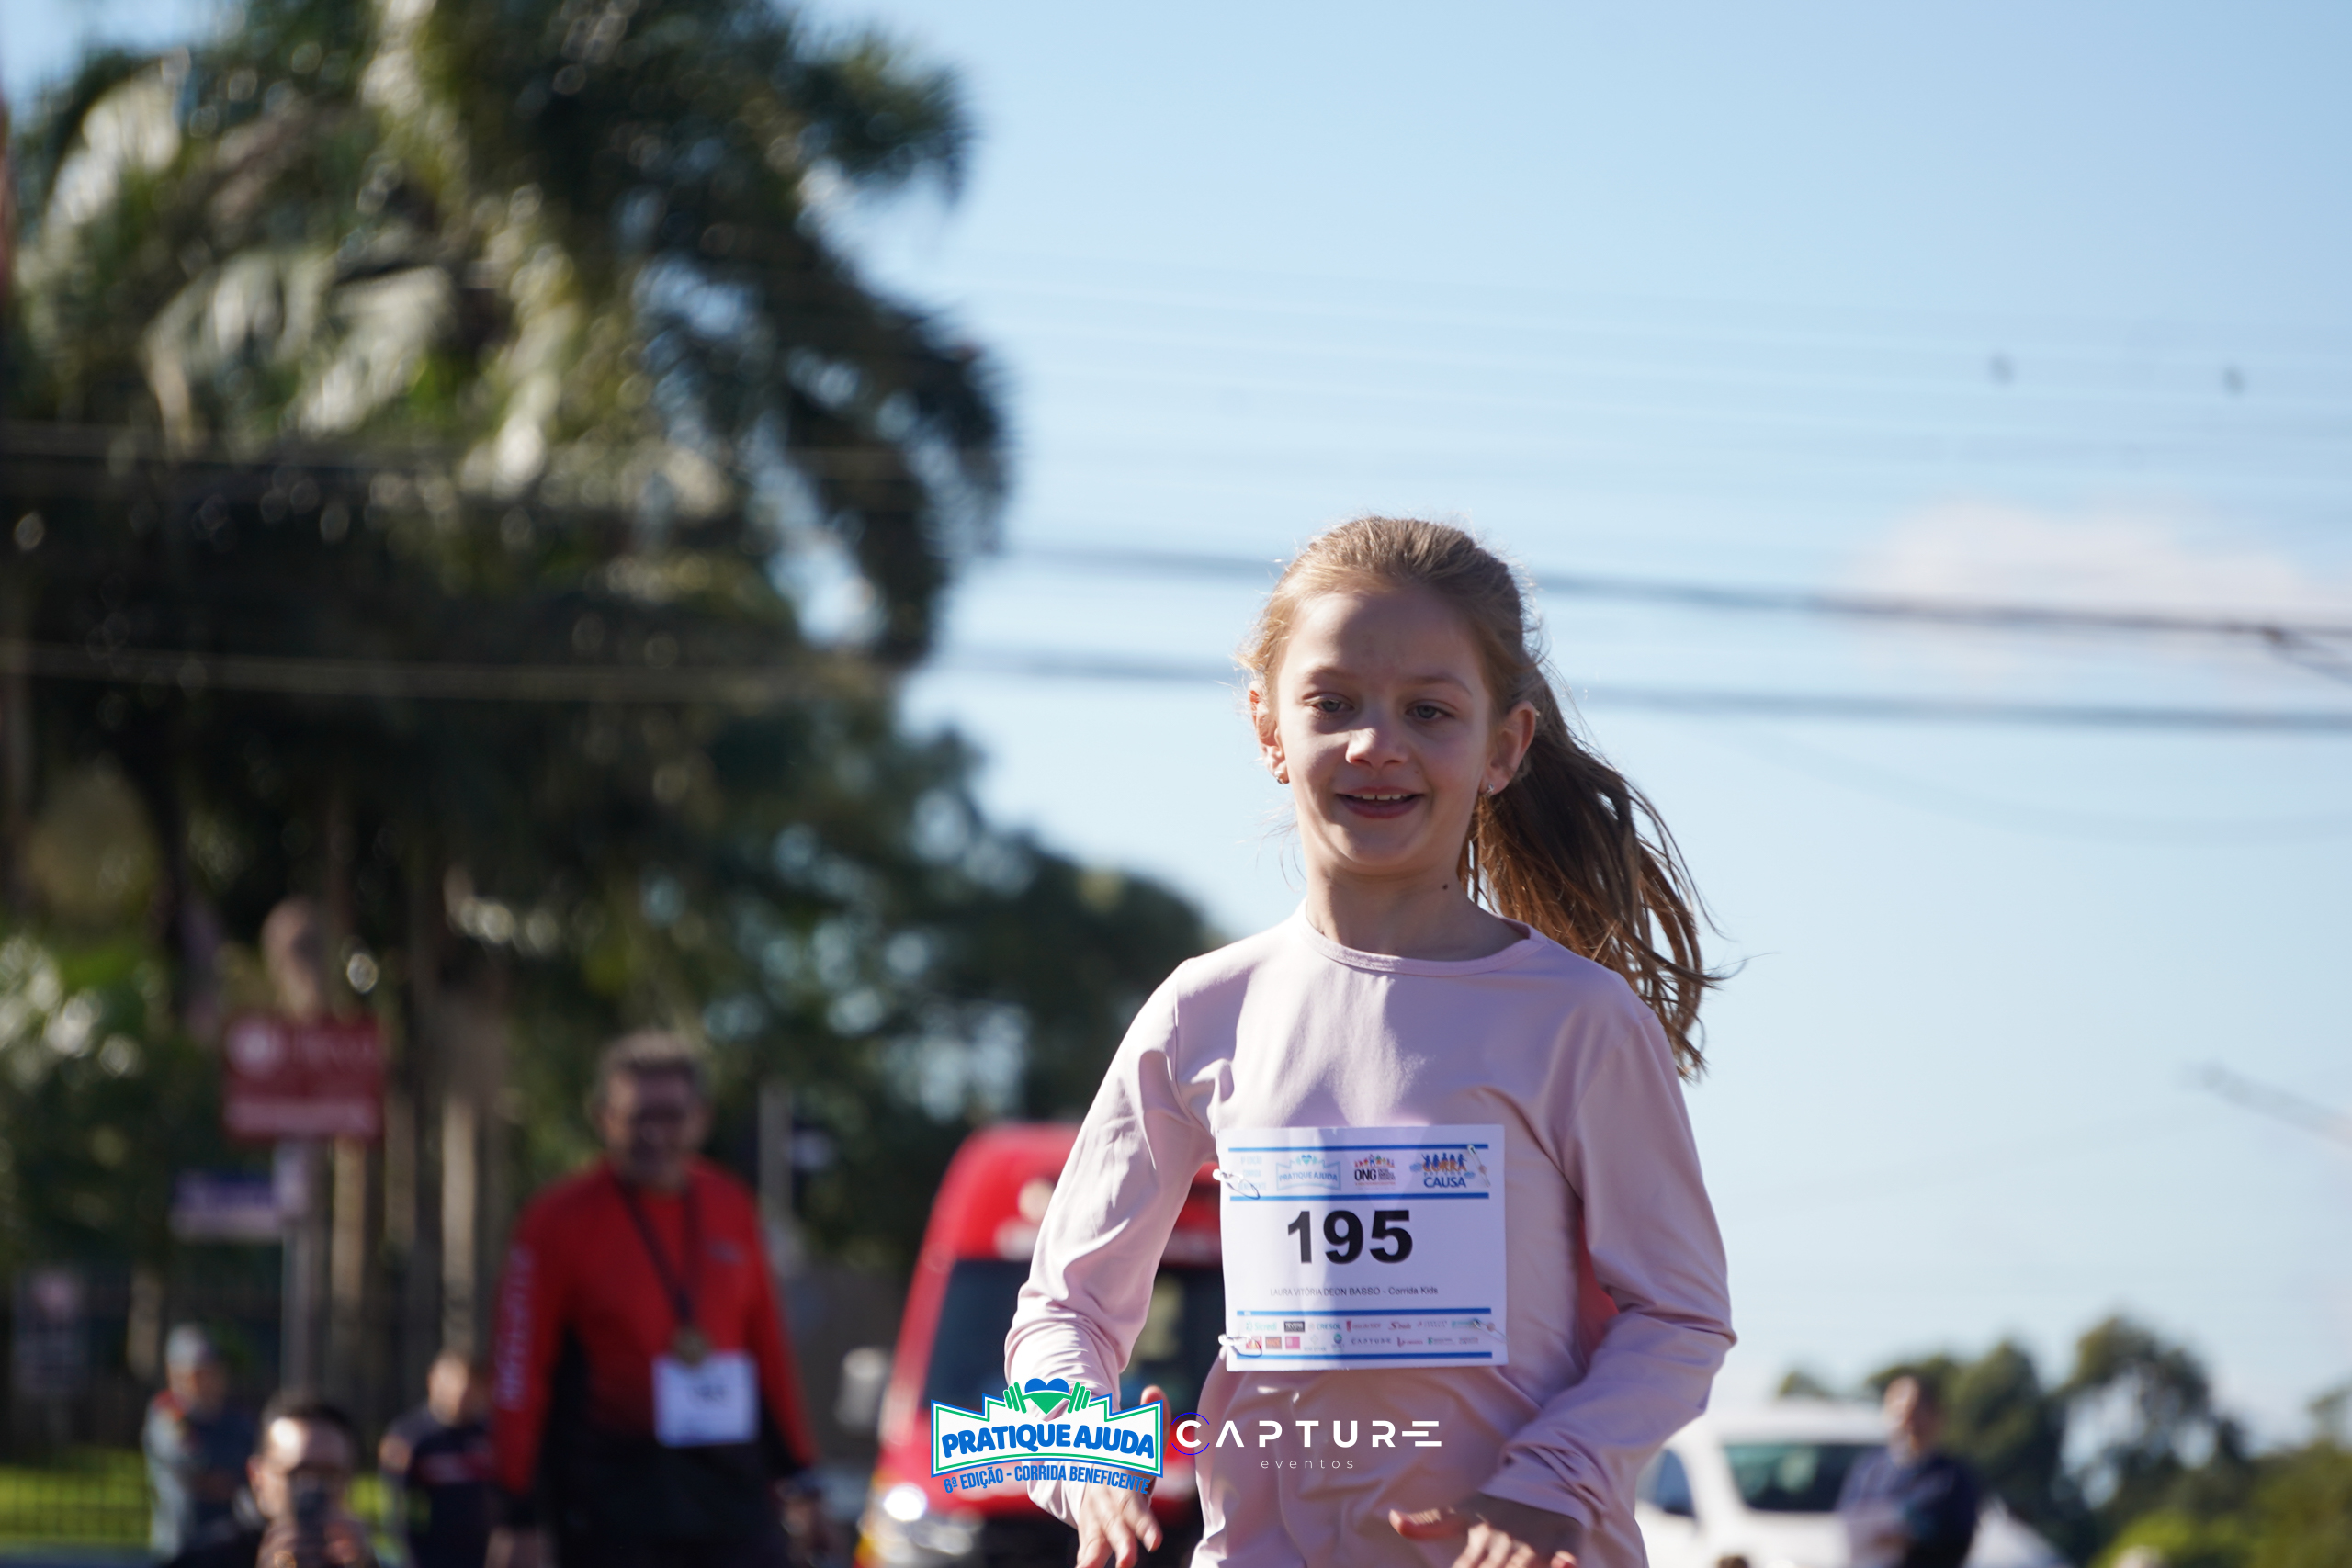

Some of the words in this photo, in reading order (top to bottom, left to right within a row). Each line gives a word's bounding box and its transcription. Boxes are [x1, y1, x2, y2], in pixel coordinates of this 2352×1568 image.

[1279, 1172, 1312, 1181] PRATIQUE
[1314, 1172, 1338, 1181] AJUDA
[1354, 1168, 1377, 1181] ONG
[1424, 1177, 1467, 1188] CAUSA
[1287, 1209, 1413, 1265] 195
[1271, 1288, 1293, 1296] LAURA
[1293, 1286, 1324, 1296] VITÓRIA
[1324, 1288, 1347, 1296] DEON
[1349, 1288, 1381, 1296] BASSO
[1388, 1287, 1419, 1295] Corrida
[1421, 1286, 1439, 1295] Kids
